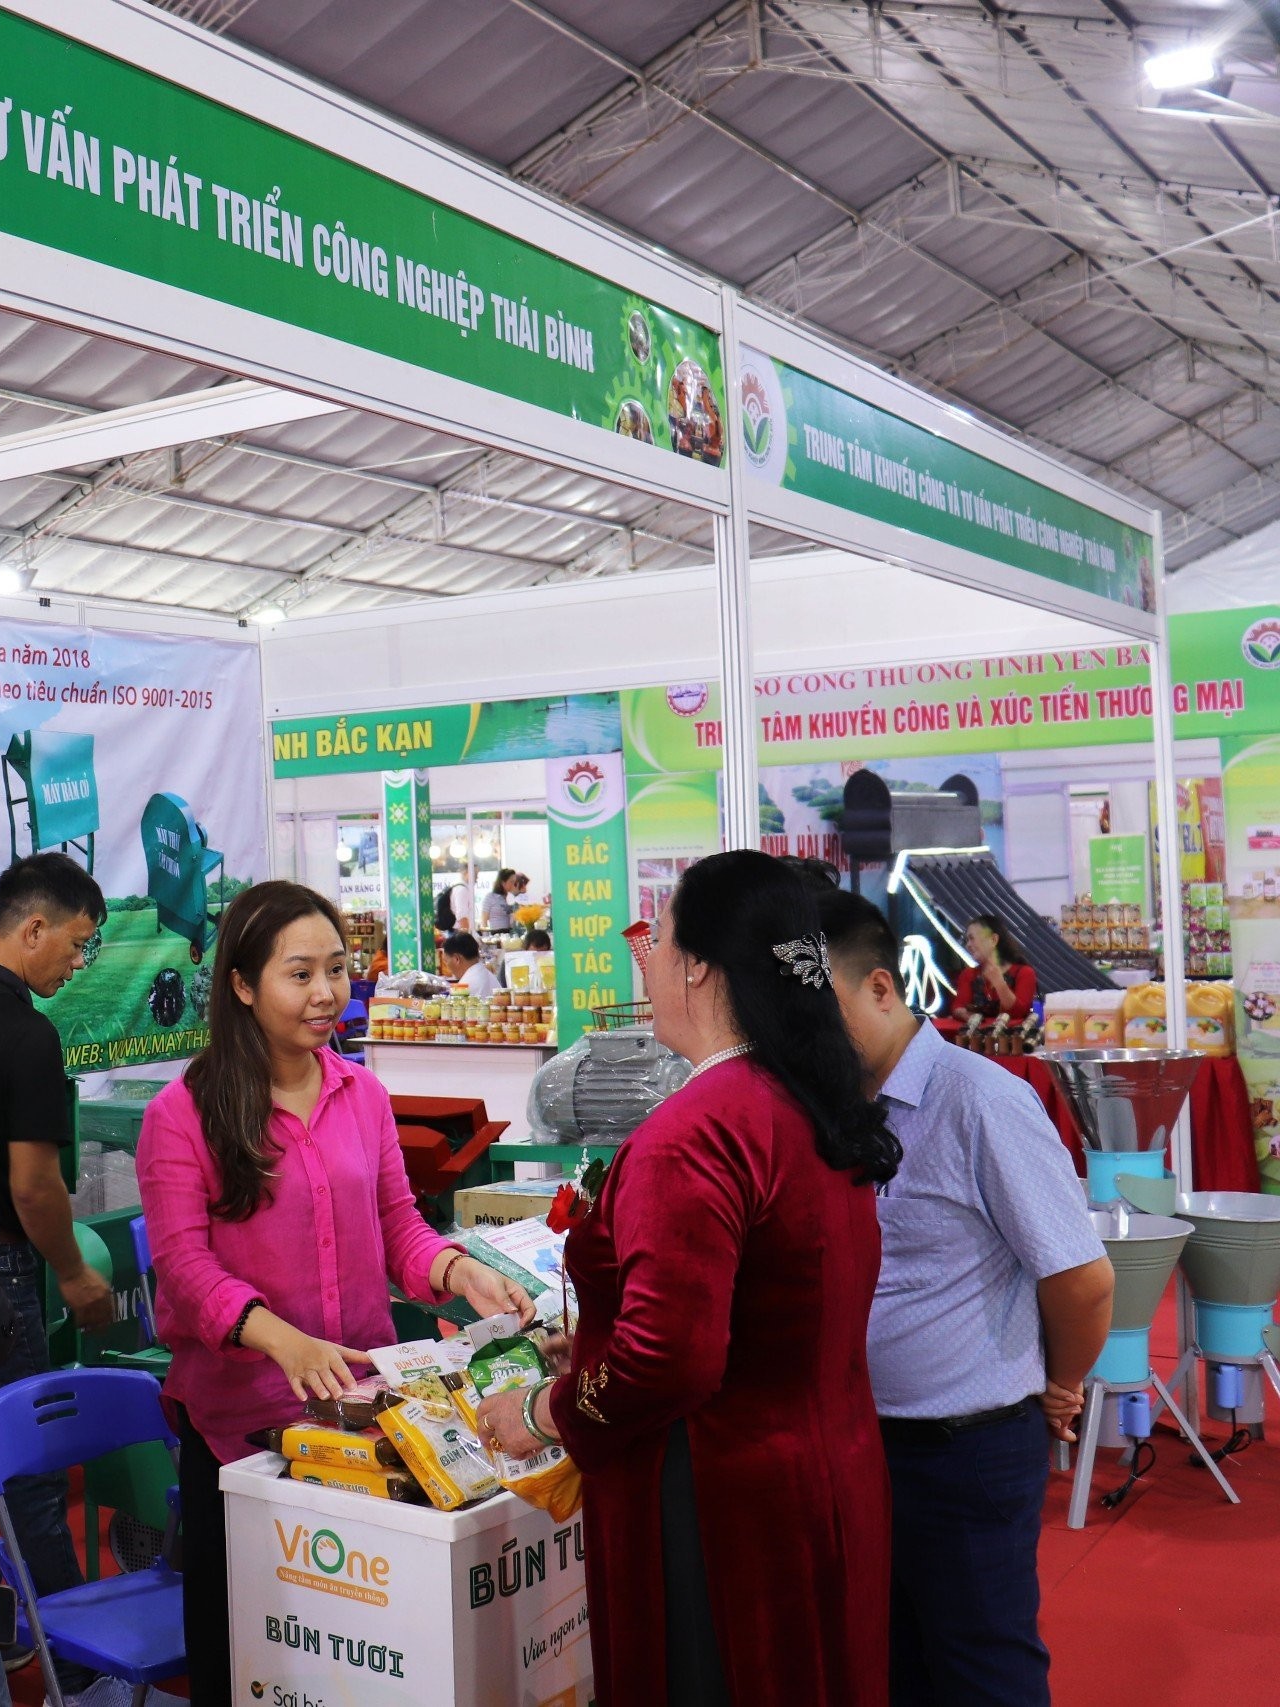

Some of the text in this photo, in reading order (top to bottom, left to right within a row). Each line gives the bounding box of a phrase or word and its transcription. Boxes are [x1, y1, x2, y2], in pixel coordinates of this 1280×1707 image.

[20, 105, 101, 196] VẤN
[113, 144, 202, 231] PHÁT
[211, 182, 304, 268] TRIỂN
[312, 221, 389, 299] CÔNG
[396, 253, 485, 338] NGHIỆP
[491, 292, 540, 355] THÁI
[545, 309, 595, 374] BÌNH
[803, 422, 846, 472] TRUNG
[847, 438, 873, 483] TÂM
[874, 453, 918, 501] KHUYẾN
[918, 468, 947, 512] CÔNG
[946, 480, 961, 517] VÀ
[992, 502, 1014, 537] PHÁT
[11, 643, 48, 666] năm
[52, 647, 91, 669] 2018
[26, 680, 56, 702] tiêu
[60, 680, 108, 705] chuẩn
[112, 684, 137, 706] ISO
[141, 687, 213, 710] 9001-2015
[760, 710, 803, 743] TÂM
[807, 701, 888, 740] KHUYẾN
[892, 699, 951, 734] CÔNG
[955, 695, 985, 730] VÀ
[989, 691, 1033, 727] XÚC
[1039, 683, 1090, 724] TIẾN
[1195, 678, 1245, 717] MẠI
[315, 717, 368, 757] BẮC
[375, 720, 433, 757] KẠN
[565, 835, 609, 866] BẮC
[567, 879, 612, 906] KẠN
[569, 914, 613, 942] HỢP
[572, 947, 613, 974] TÁC
[65, 1043, 105, 1067] WEB:
[273, 1518, 390, 1587] ViOne
[550, 1616, 576, 1658] ngon
[327, 1633, 404, 1679] TƯƠI
